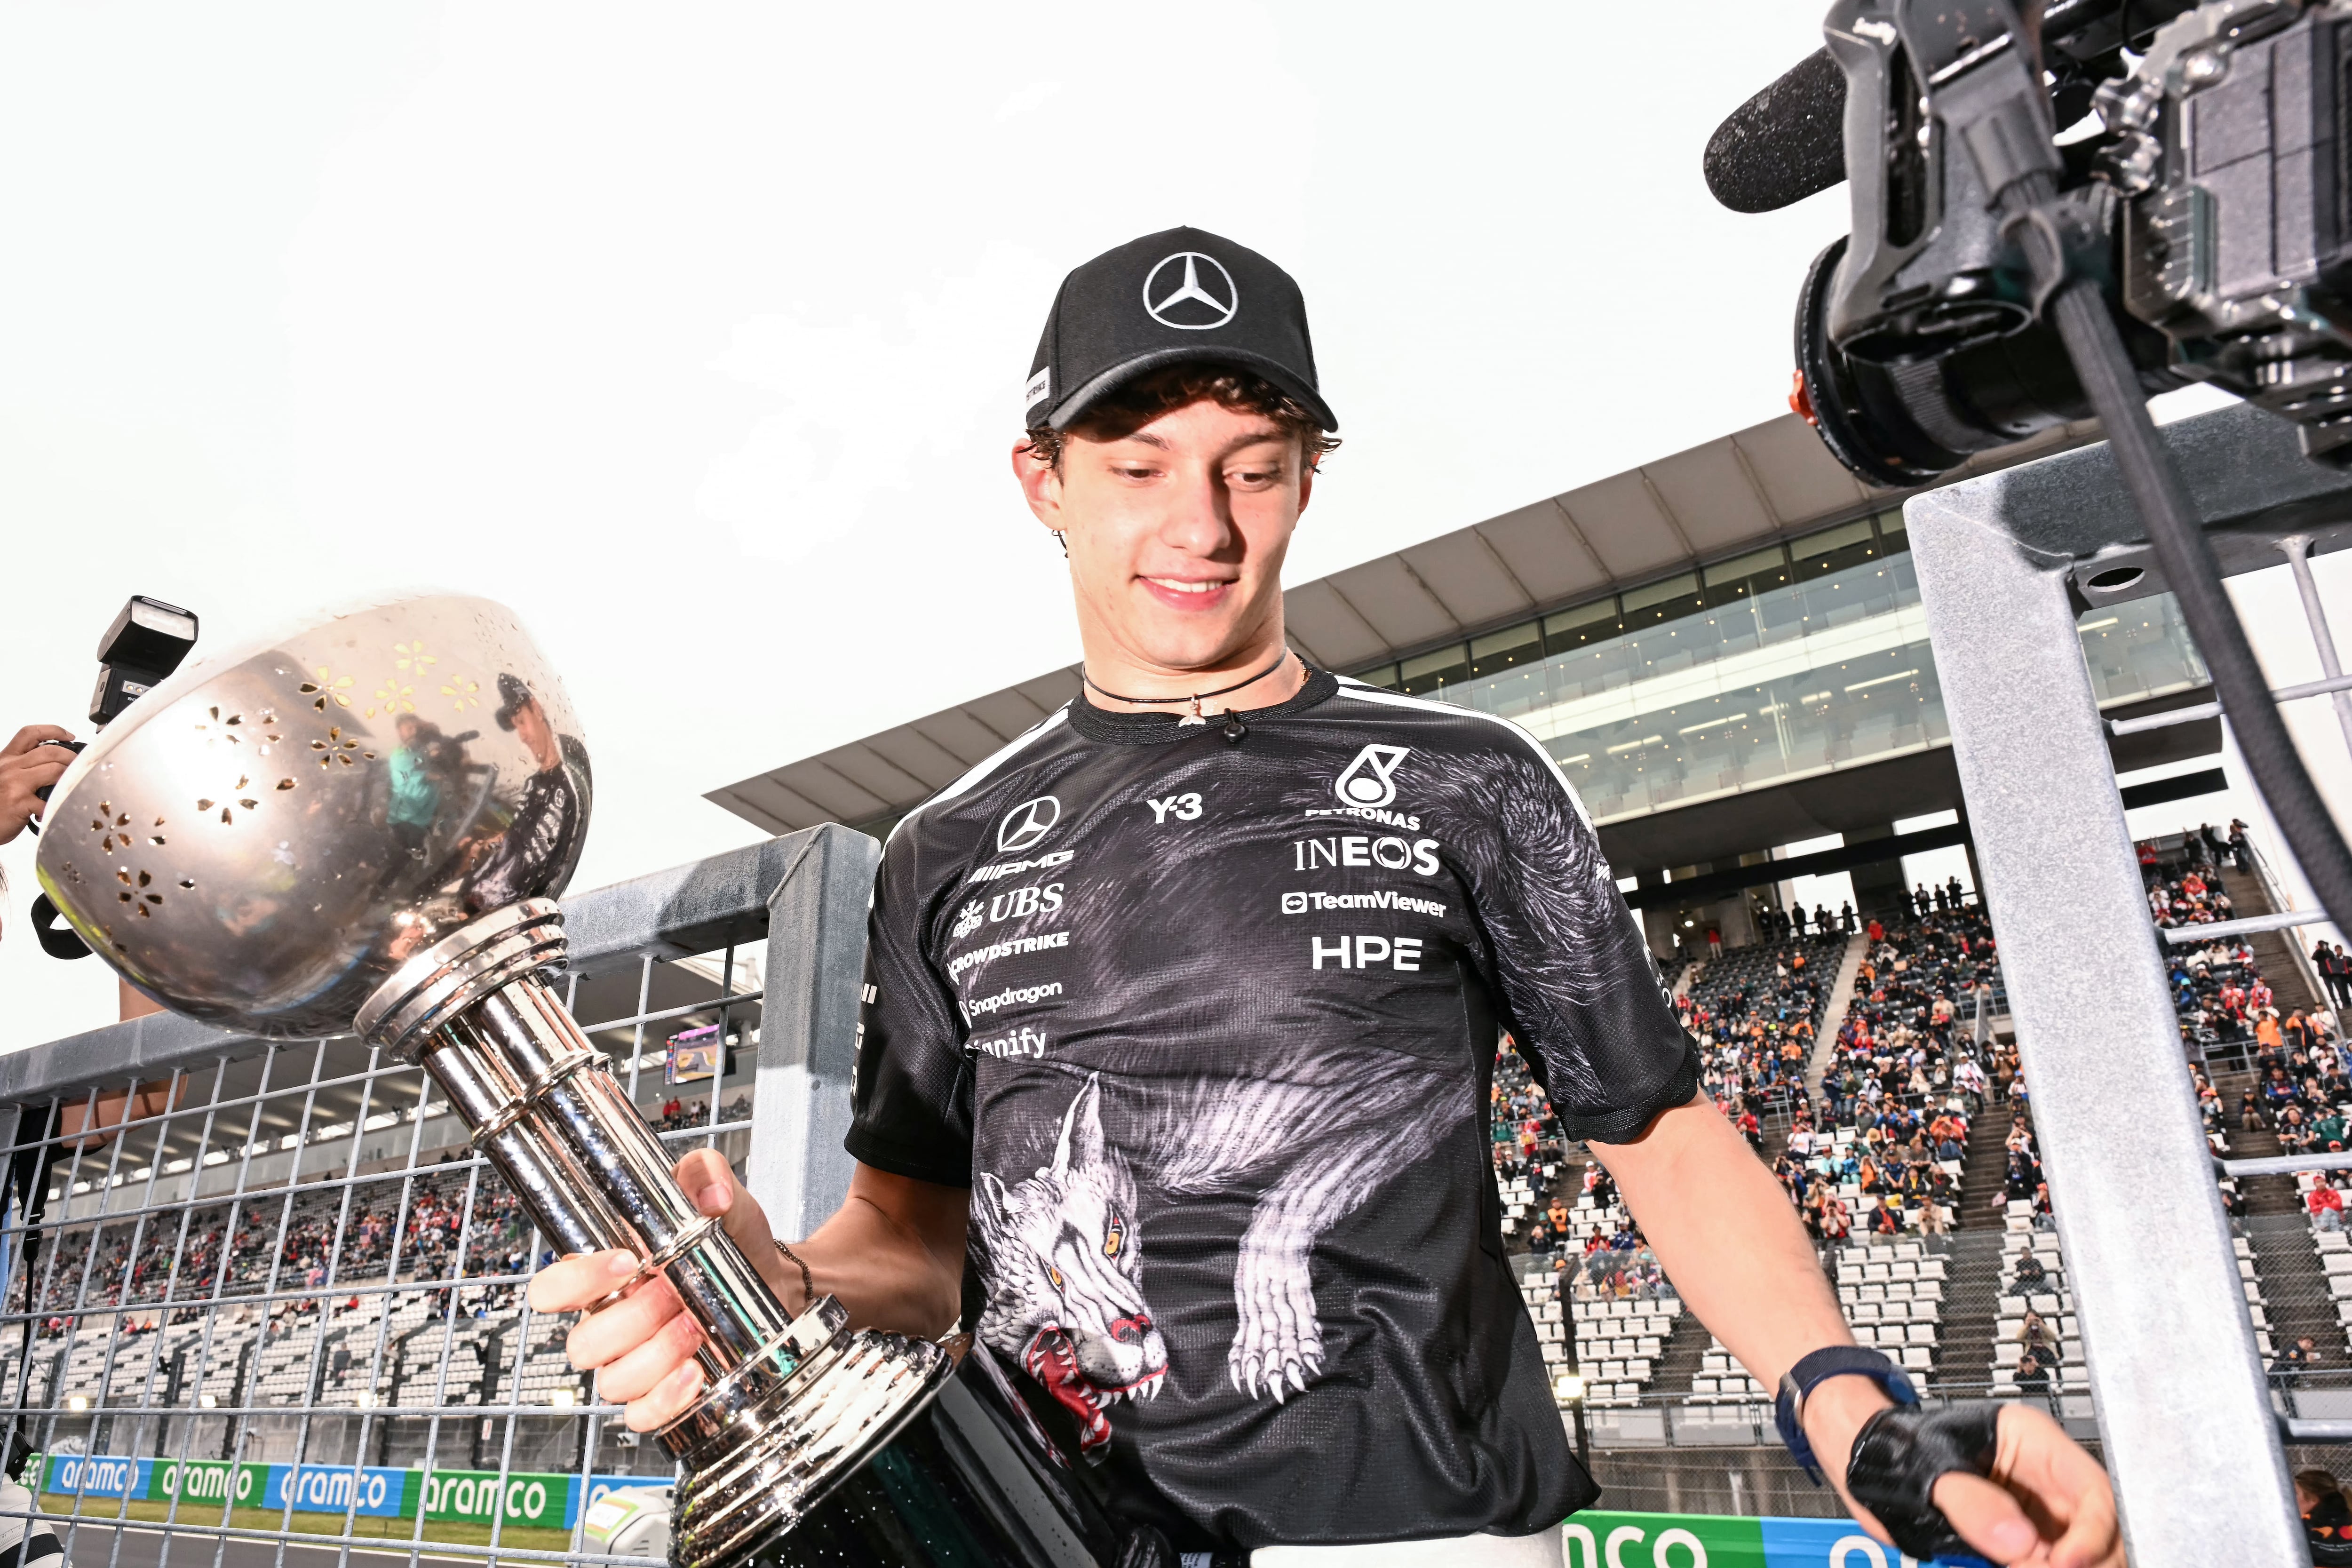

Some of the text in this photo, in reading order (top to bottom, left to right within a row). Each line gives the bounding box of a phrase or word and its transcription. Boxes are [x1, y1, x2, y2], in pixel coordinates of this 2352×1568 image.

[1146, 793, 1203, 824] Y-3
[1305, 807, 1421, 831] PETRONAS
[994, 850, 1074, 879] AMG
[1294, 836, 1440, 876] INEOS
[990, 883, 1064, 923] UBS
[1308, 891, 1446, 918] TeamViewer
[951, 931, 1070, 974] CROWDSTRIKE
[1312, 936, 1422, 971] HPE
[969, 982, 1062, 1017] Snapdragon
[965, 1027, 1046, 1059] nify
